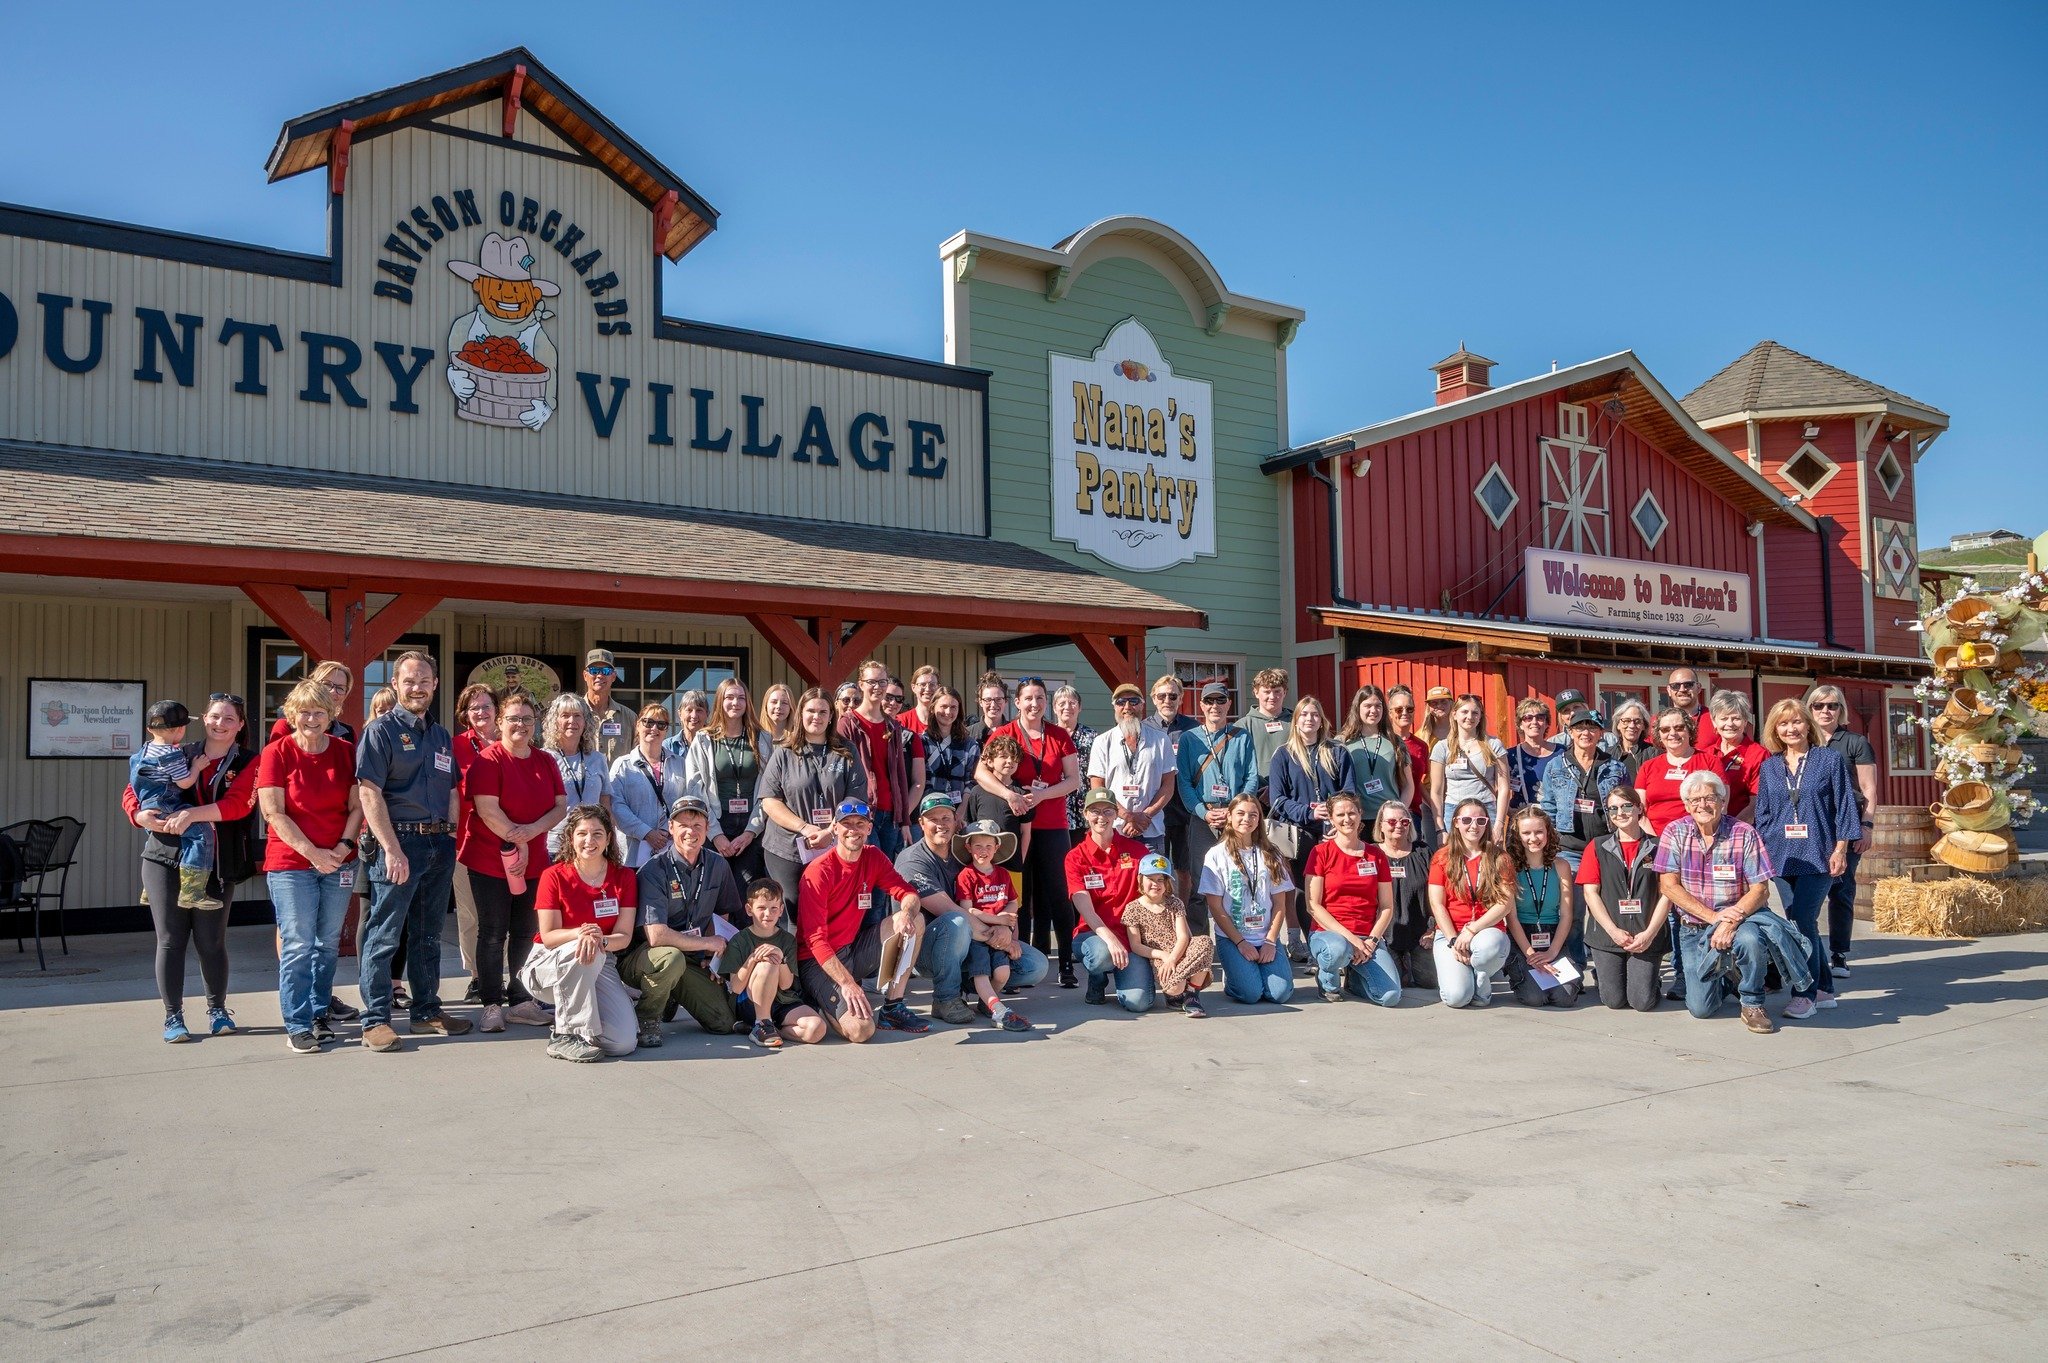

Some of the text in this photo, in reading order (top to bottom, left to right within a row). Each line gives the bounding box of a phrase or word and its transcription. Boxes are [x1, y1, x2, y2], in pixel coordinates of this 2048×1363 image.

[374, 189, 633, 336] DAVISON ORCHARDS
[576, 371, 948, 480] VILLAGE
[1073, 380, 1197, 462] Nana's
[1075, 451, 1198, 539] Pantry
[1543, 559, 1738, 613] Welcome to Davison's
[1608, 607, 1685, 623] Farming Since 1933
[482, 656, 518, 673] GRANDPA
[71, 704, 134, 715] Davison Orchards
[83, 714, 122, 724] Newsletter
